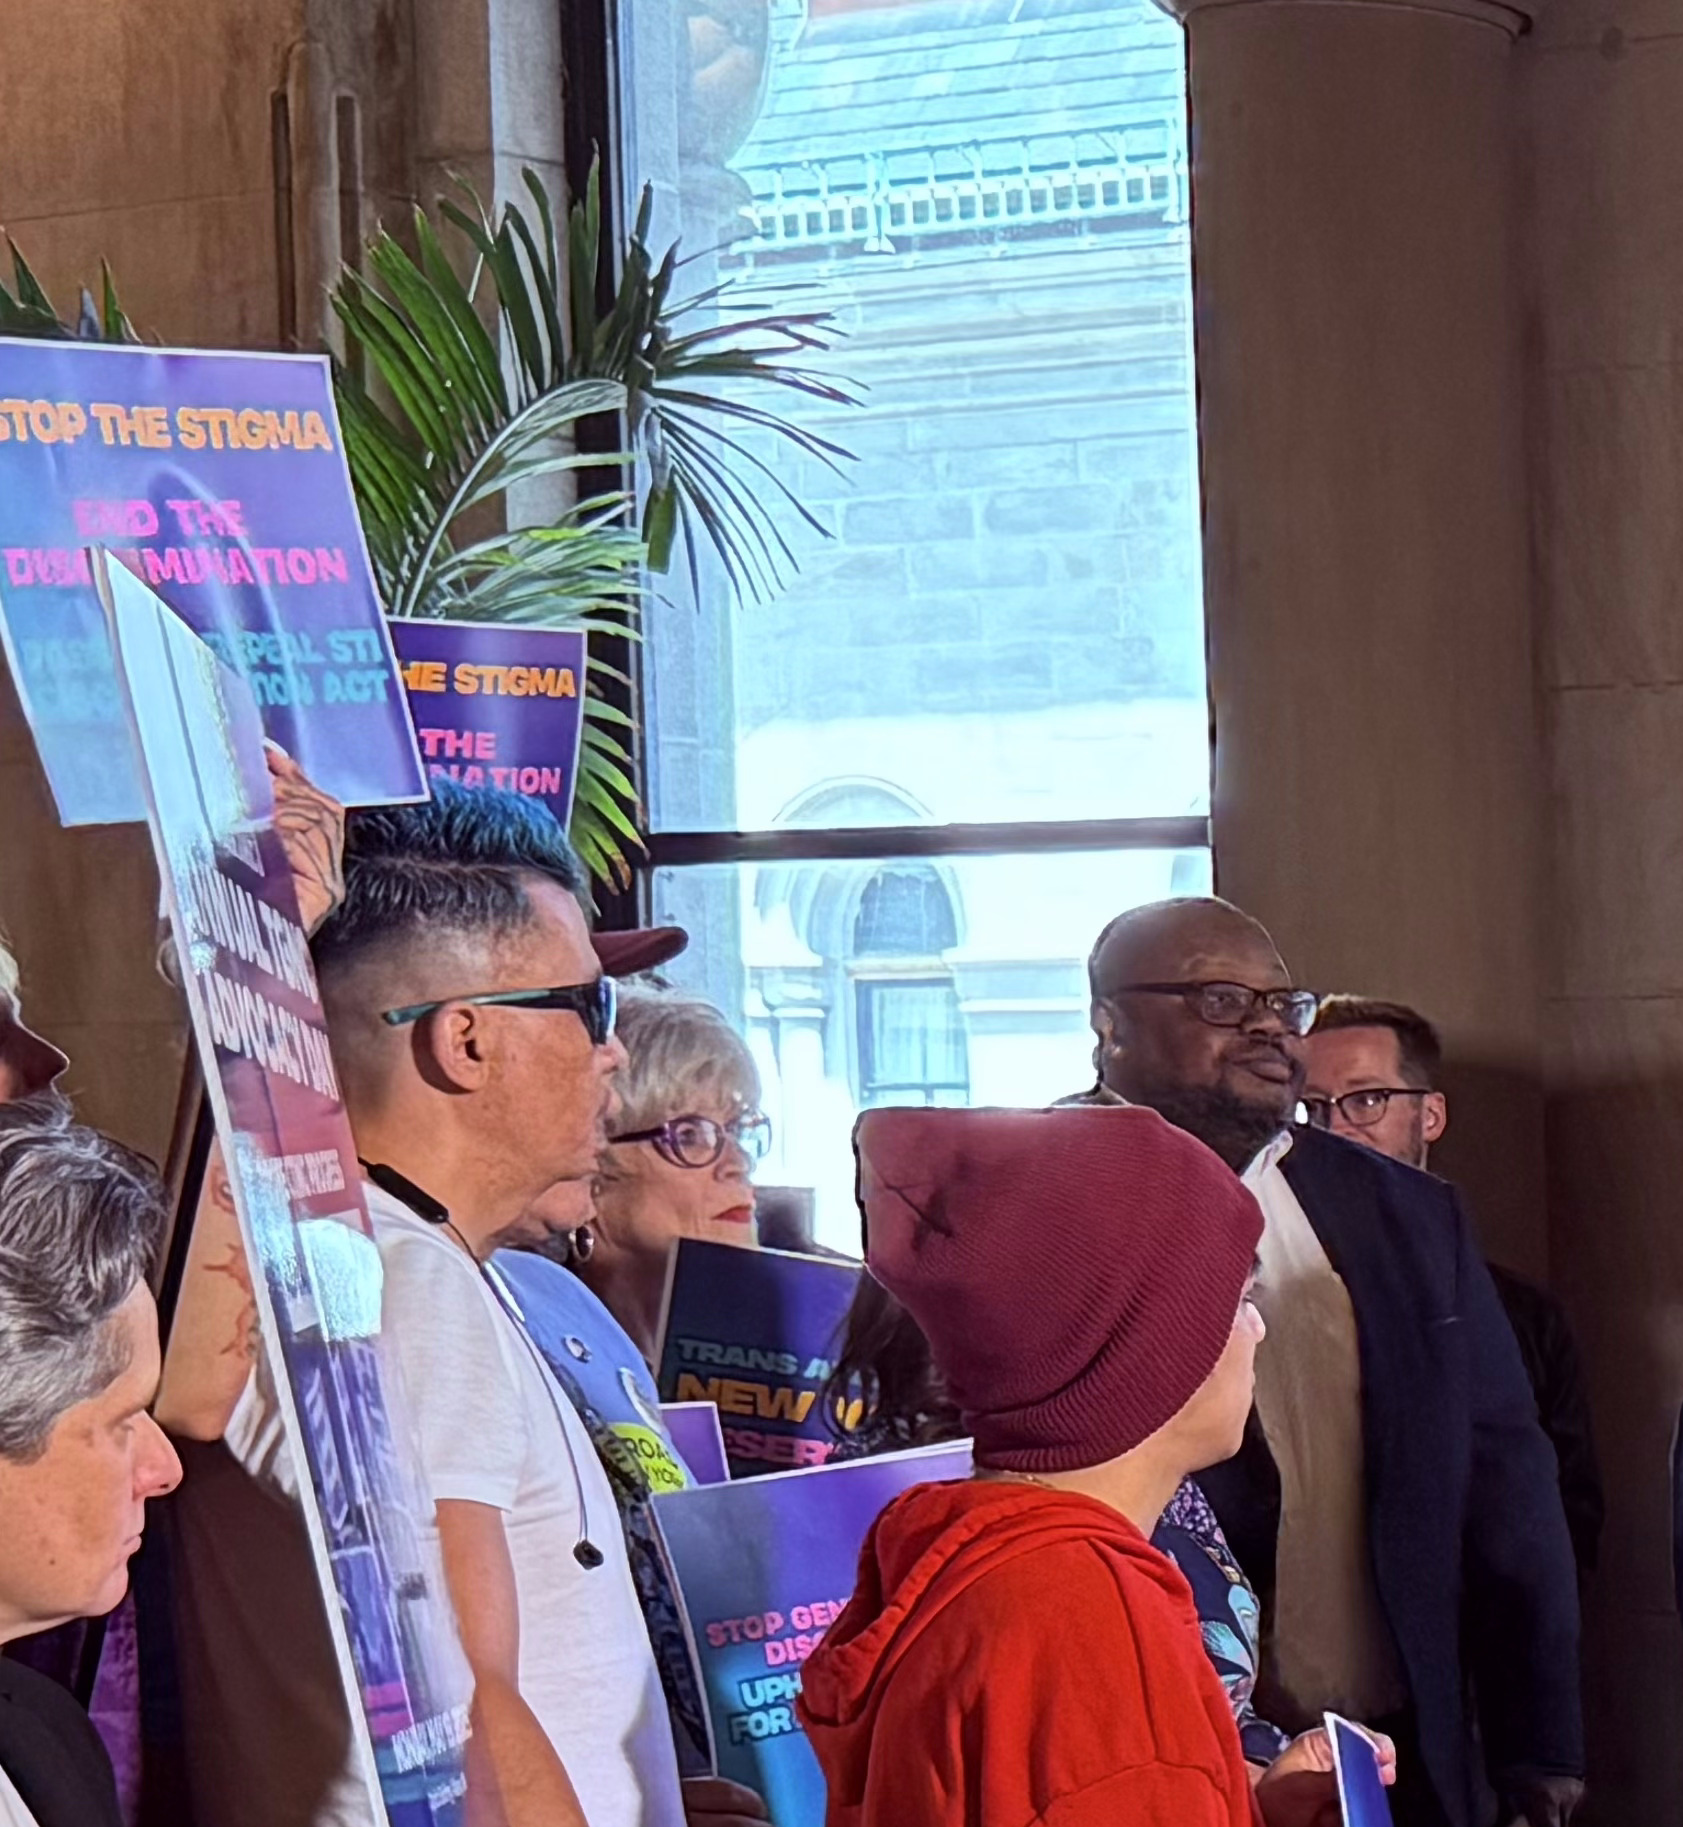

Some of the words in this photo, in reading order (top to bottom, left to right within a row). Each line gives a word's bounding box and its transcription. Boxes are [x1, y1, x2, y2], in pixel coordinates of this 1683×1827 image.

[90, 403, 172, 449] THE
[177, 407, 334, 451] STIGMA
[402, 661, 448, 692] HE
[453, 663, 576, 698] STIGMA
[419, 728, 497, 760] THE
[677, 1337, 799, 1376] TRANS
[676, 1372, 817, 1424] NEW
[704, 1610, 785, 1648] STOP
[730, 1706, 793, 1744] FOR
